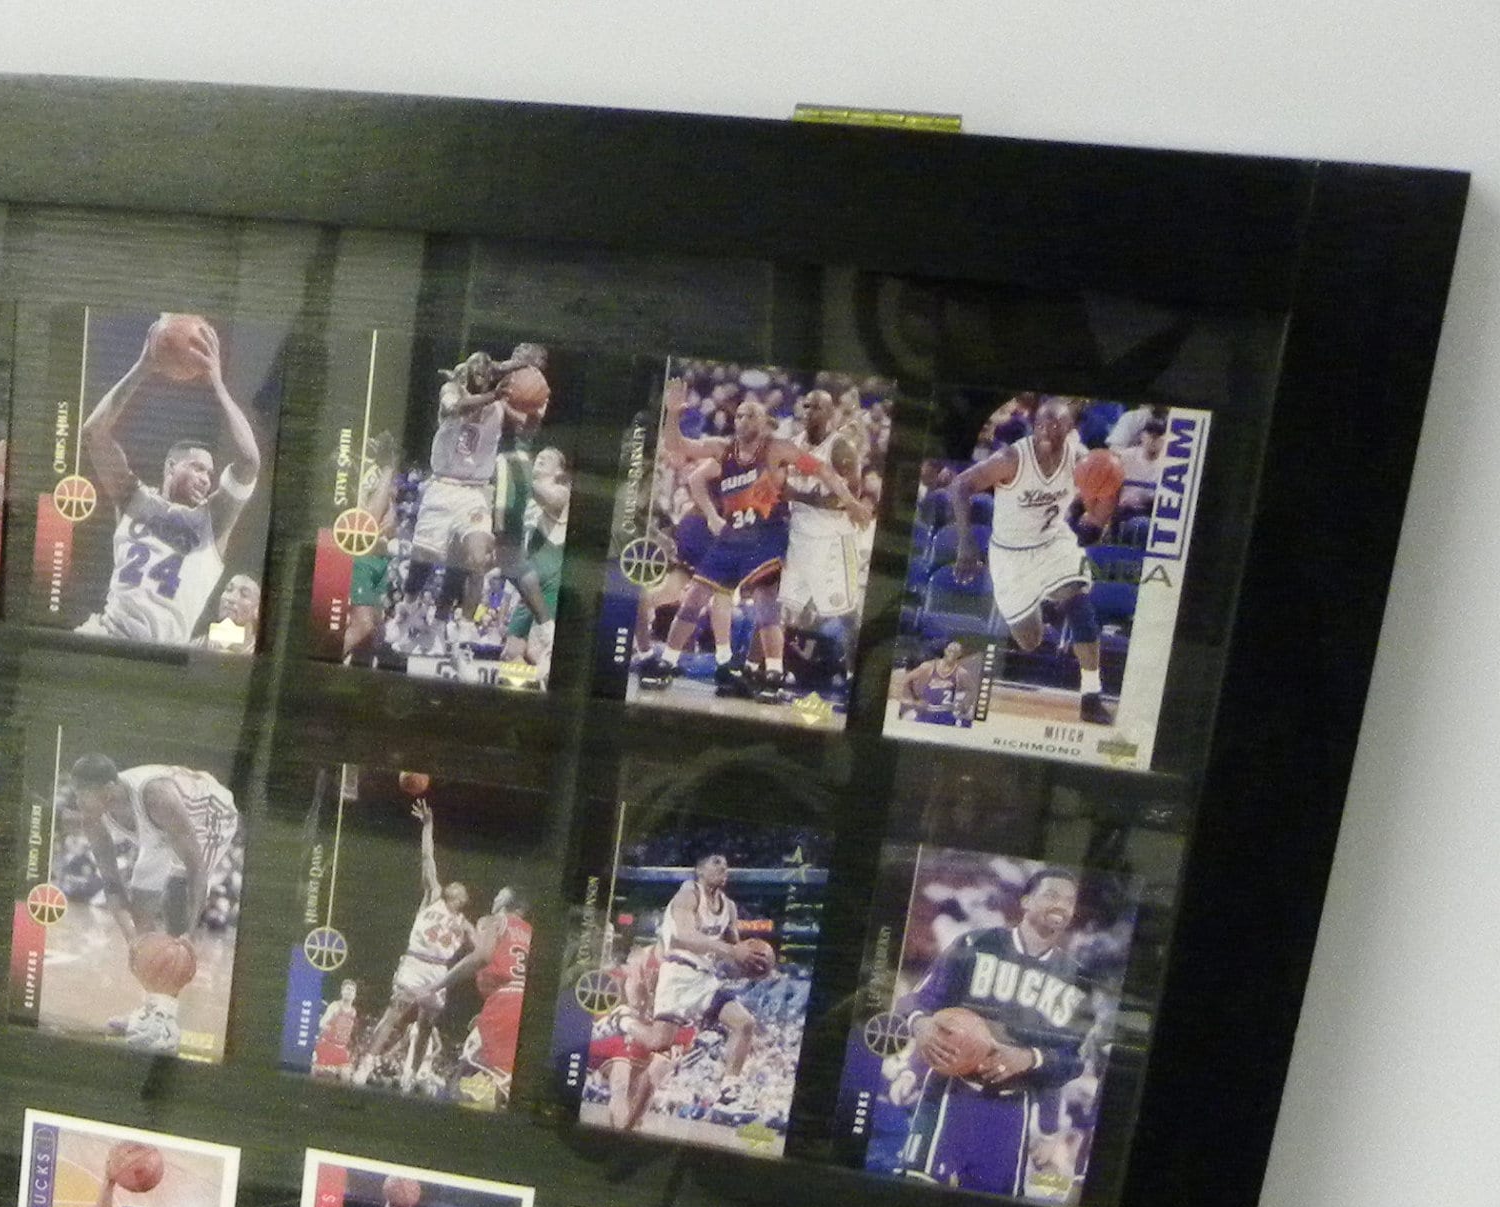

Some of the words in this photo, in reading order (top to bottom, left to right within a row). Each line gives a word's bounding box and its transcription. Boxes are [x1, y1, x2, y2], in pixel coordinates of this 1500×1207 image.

[1150, 417, 1197, 548] TEAM
[732, 507, 758, 529] 34
[117, 542, 182, 600] 24
[992, 738, 1082, 757] RICHMOND
[1044, 725, 1085, 744] MITCH
[24, 950, 38, 1009] CLIPPERS
[969, 952, 1087, 1028] BUCKS
[298, 999, 313, 1047] KNICKS
[566, 1052, 582, 1087] SUNS
[852, 1090, 871, 1135] BUCKS
